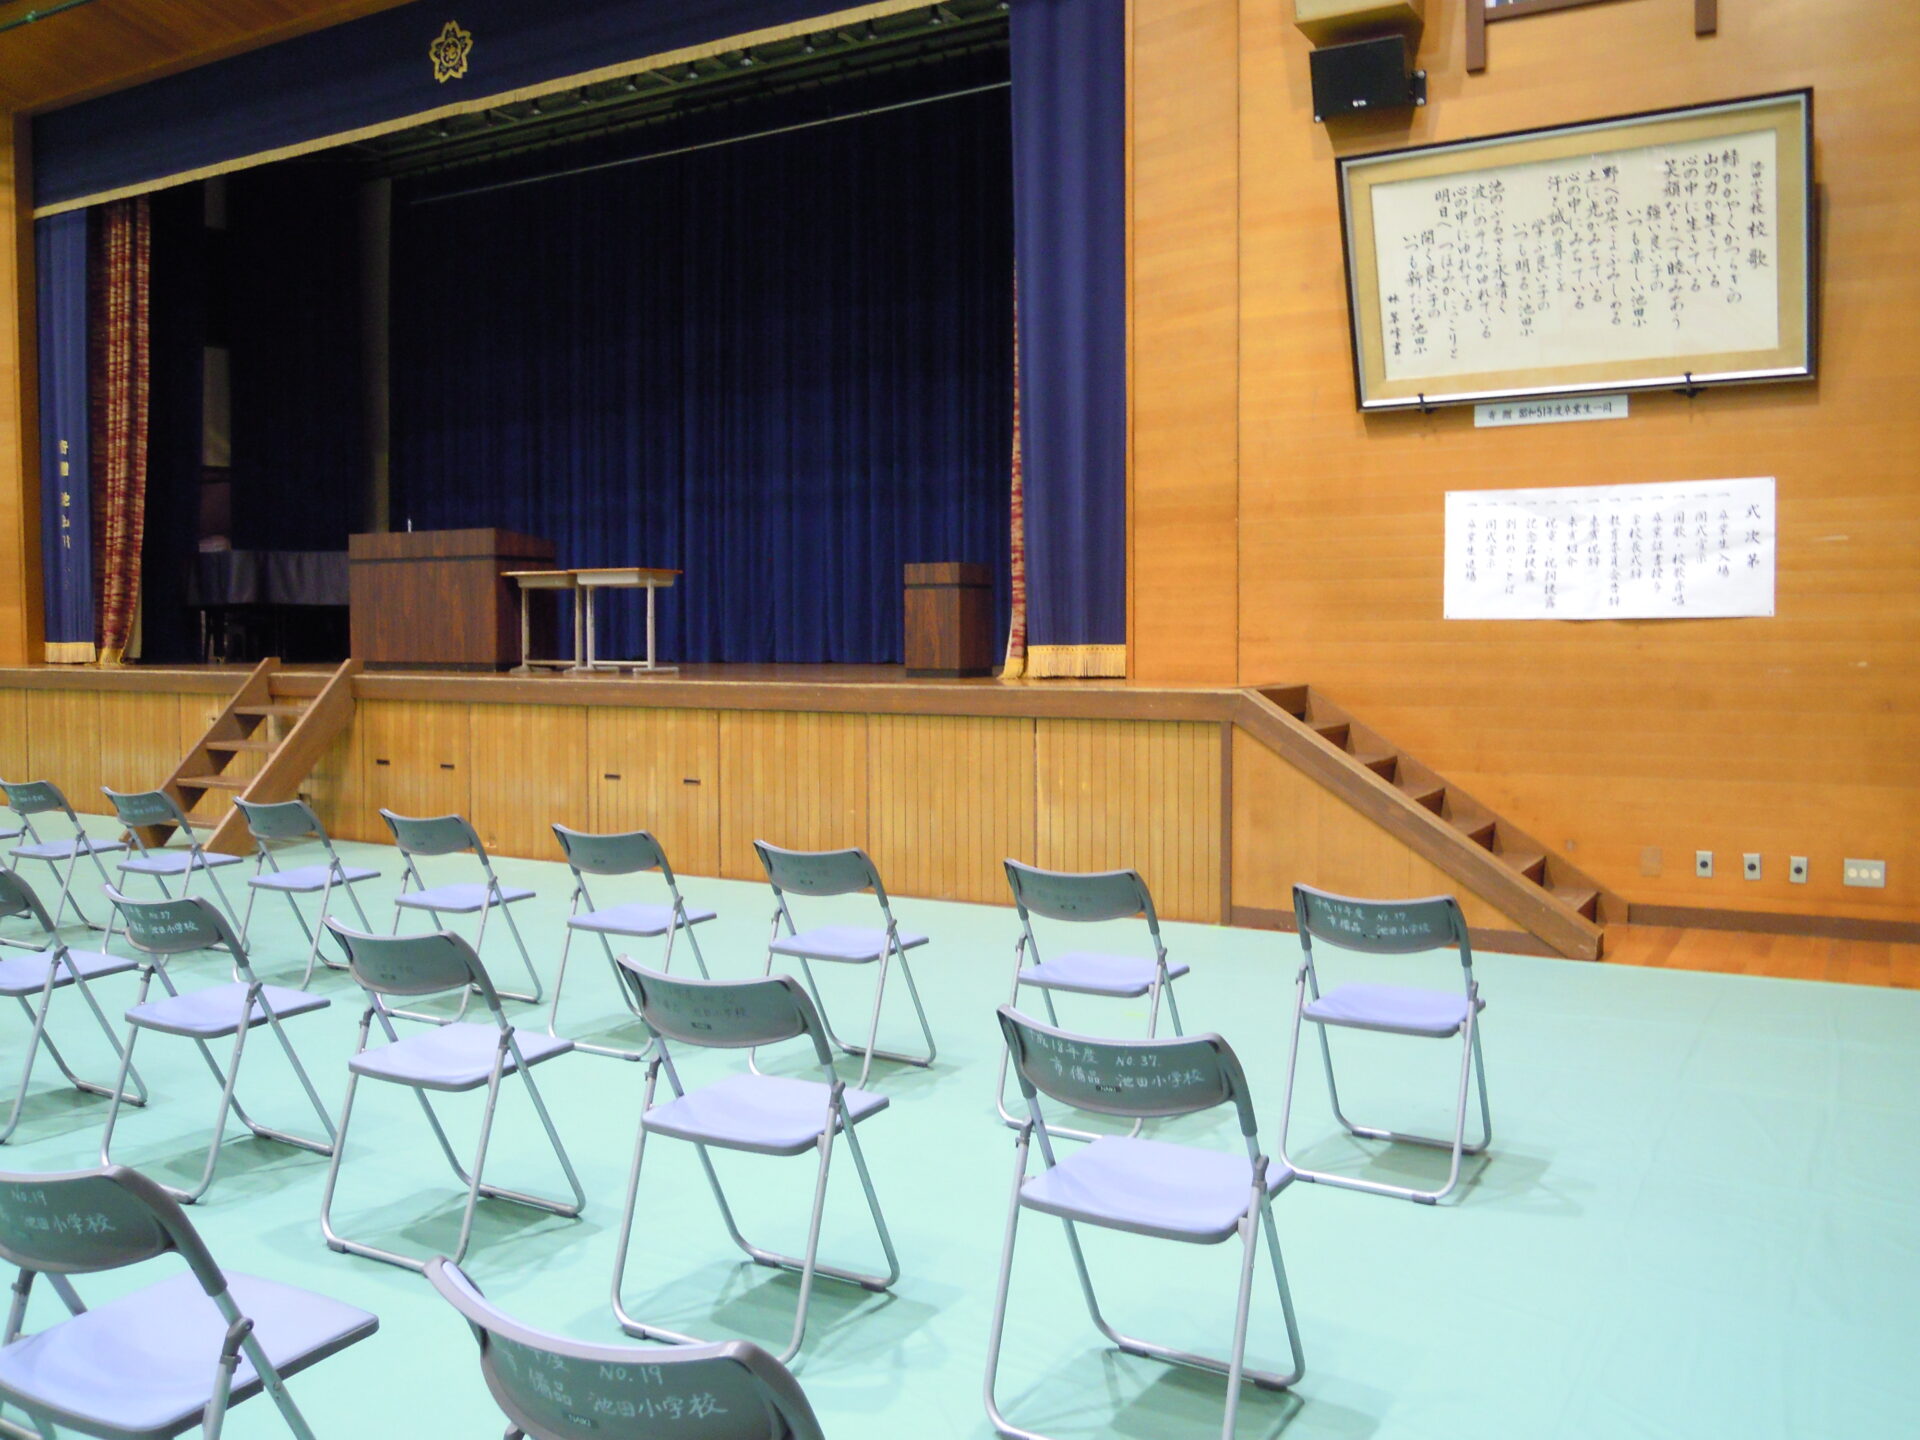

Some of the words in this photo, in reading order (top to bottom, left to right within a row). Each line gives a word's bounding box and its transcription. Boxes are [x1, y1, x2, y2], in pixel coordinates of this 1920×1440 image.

[1117, 1068, 1206, 1089] 池田小学校
[586, 1391, 729, 1420] 池田小学校
